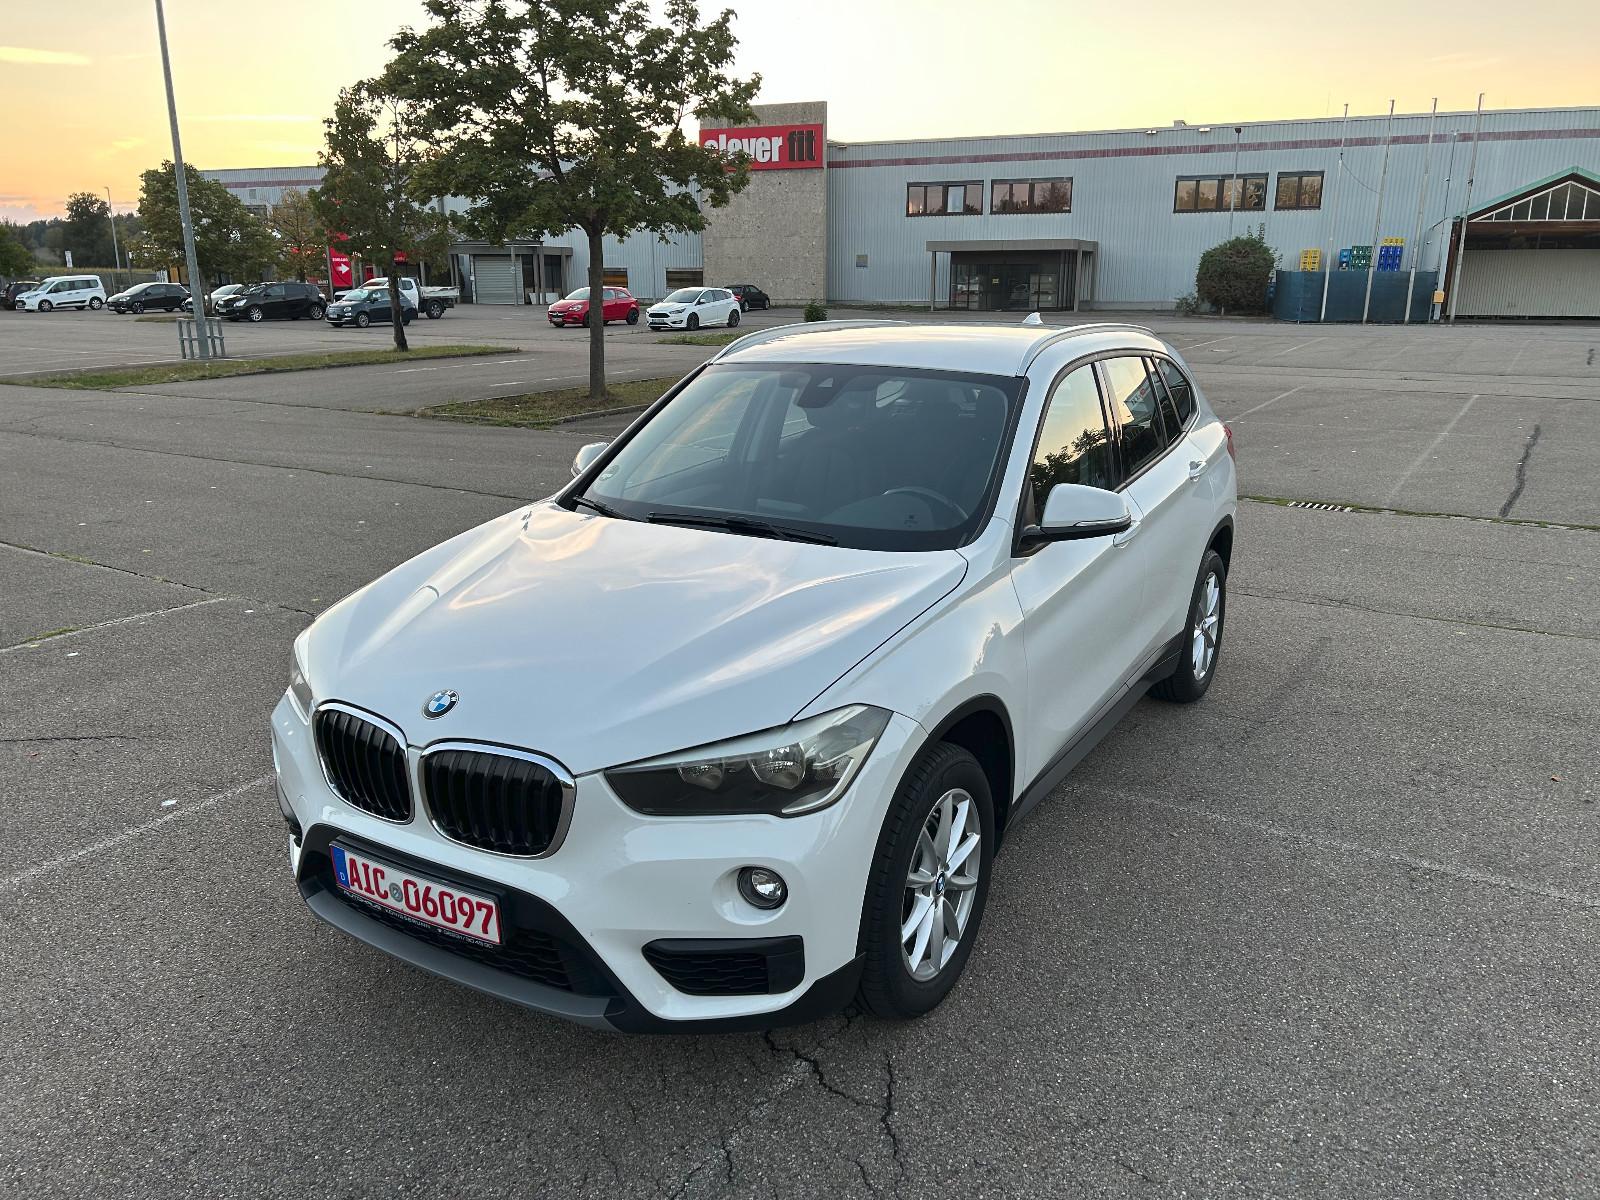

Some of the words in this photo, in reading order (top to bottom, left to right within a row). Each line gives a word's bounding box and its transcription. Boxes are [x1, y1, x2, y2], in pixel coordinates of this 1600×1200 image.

[787, 129, 817, 162] fit
[349, 857, 389, 900] AIC
[402, 878, 494, 935] 06097
